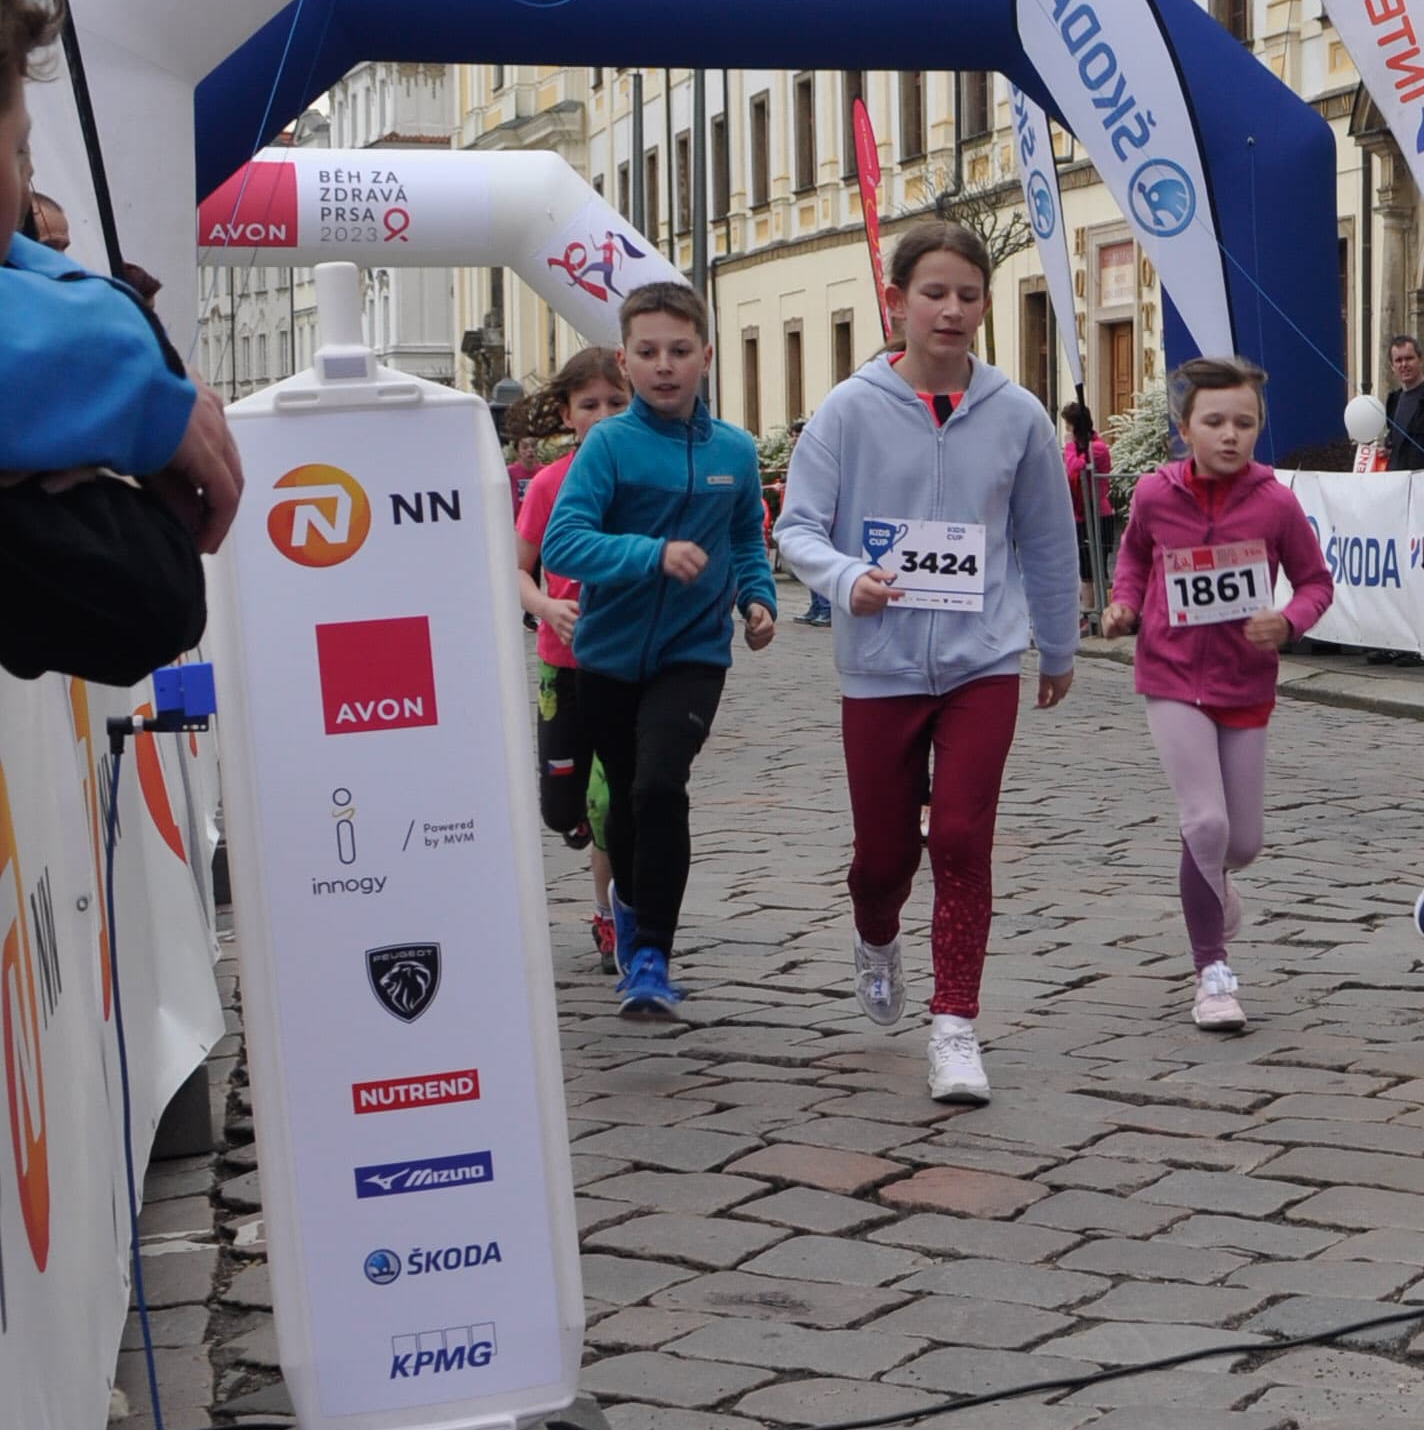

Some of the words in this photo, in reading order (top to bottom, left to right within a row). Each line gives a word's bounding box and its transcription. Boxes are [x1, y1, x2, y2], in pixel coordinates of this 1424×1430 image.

[319, 168, 361, 184] BĚH
[371, 170, 399, 184] ZA
[319, 185, 408, 202] ZDRAVÁ
[320, 207, 375, 222] PRSA
[208, 223, 287, 240] AVON
[320, 226, 378, 242] 2023
[389, 490, 461, 525] NN
[900, 550, 978, 576] 3424
[1325, 526, 1402, 589] ŠKODA
[1173, 568, 1256, 608] 1861
[334, 695, 424, 724] AVON
[423, 819, 475, 834] Powered
[424, 836, 439, 848] by
[443, 832, 475, 845] MVM
[311, 875, 388, 895] innogy
[372, 949, 433, 963] PEUGEOT
[360, 1076, 474, 1108] NUTREND
[407, 1241, 502, 1275] ŠKODA
[389, 1341, 493, 1379] KPMG
